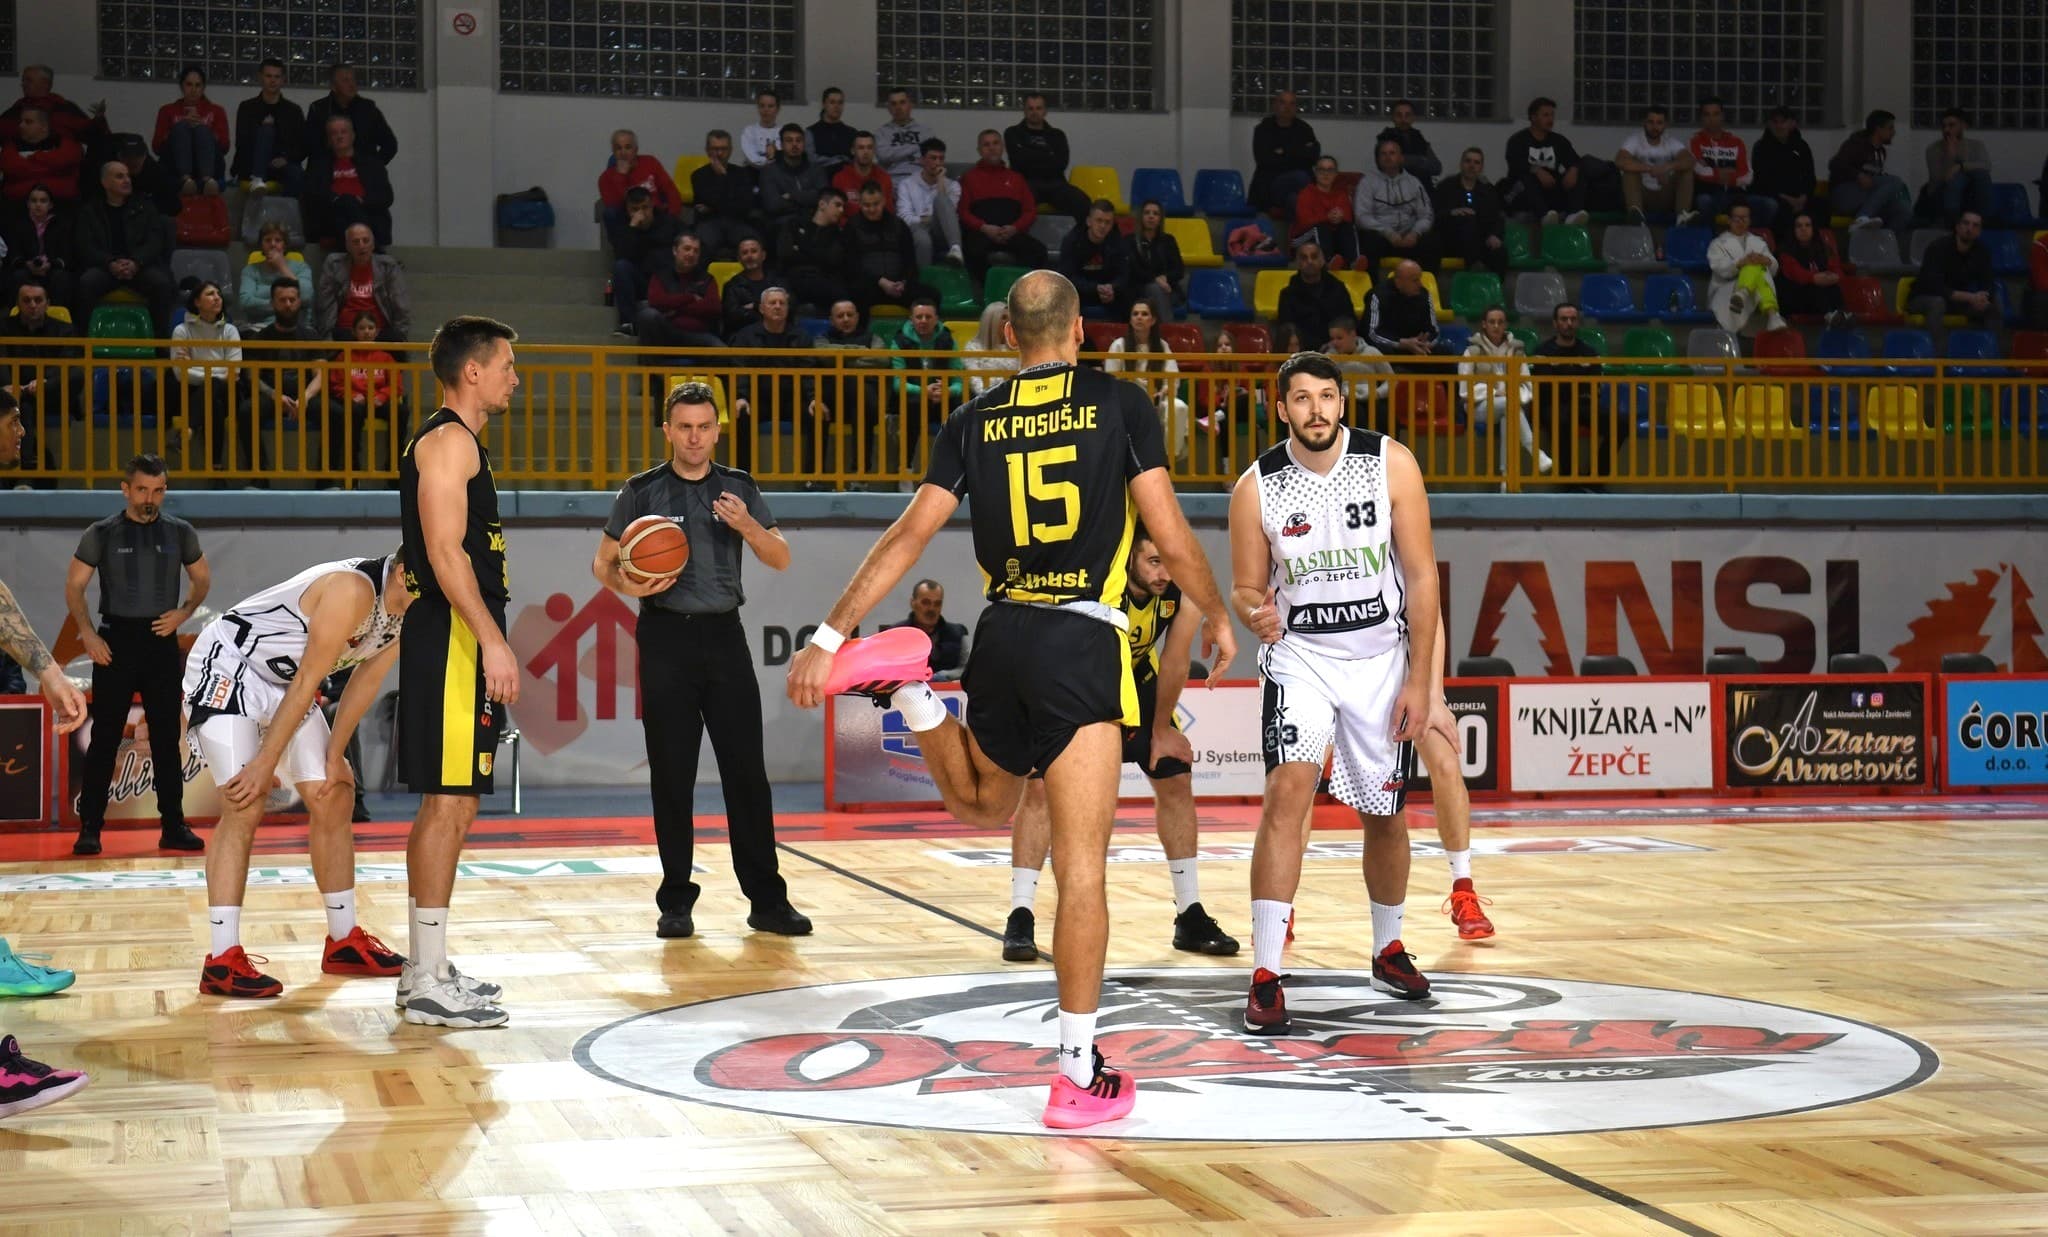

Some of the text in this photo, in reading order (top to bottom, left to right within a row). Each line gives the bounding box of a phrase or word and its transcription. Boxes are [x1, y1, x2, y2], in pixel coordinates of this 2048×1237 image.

[984, 403, 1097, 442] KK POSUŠJE
[1005, 445, 1081, 547] 15
[1345, 500, 1377, 529] 33
[1326, 570, 1361, 582] ŽEPČE
[1438, 556, 1860, 674] ANSI
[1448, 702, 1487, 711] ADEMIJA
[1265, 724, 1298, 752] 33
[1959, 701, 2048, 752] ĆOR
[1820, 728, 1916, 754] Zlatare
[1567, 746, 1651, 776] ŽEPČE
[1773, 756, 1917, 783] Ahmetović
[1985, 754, 2031, 772] d.o.o.
[1466, 1065, 1655, 1081] Žepče
